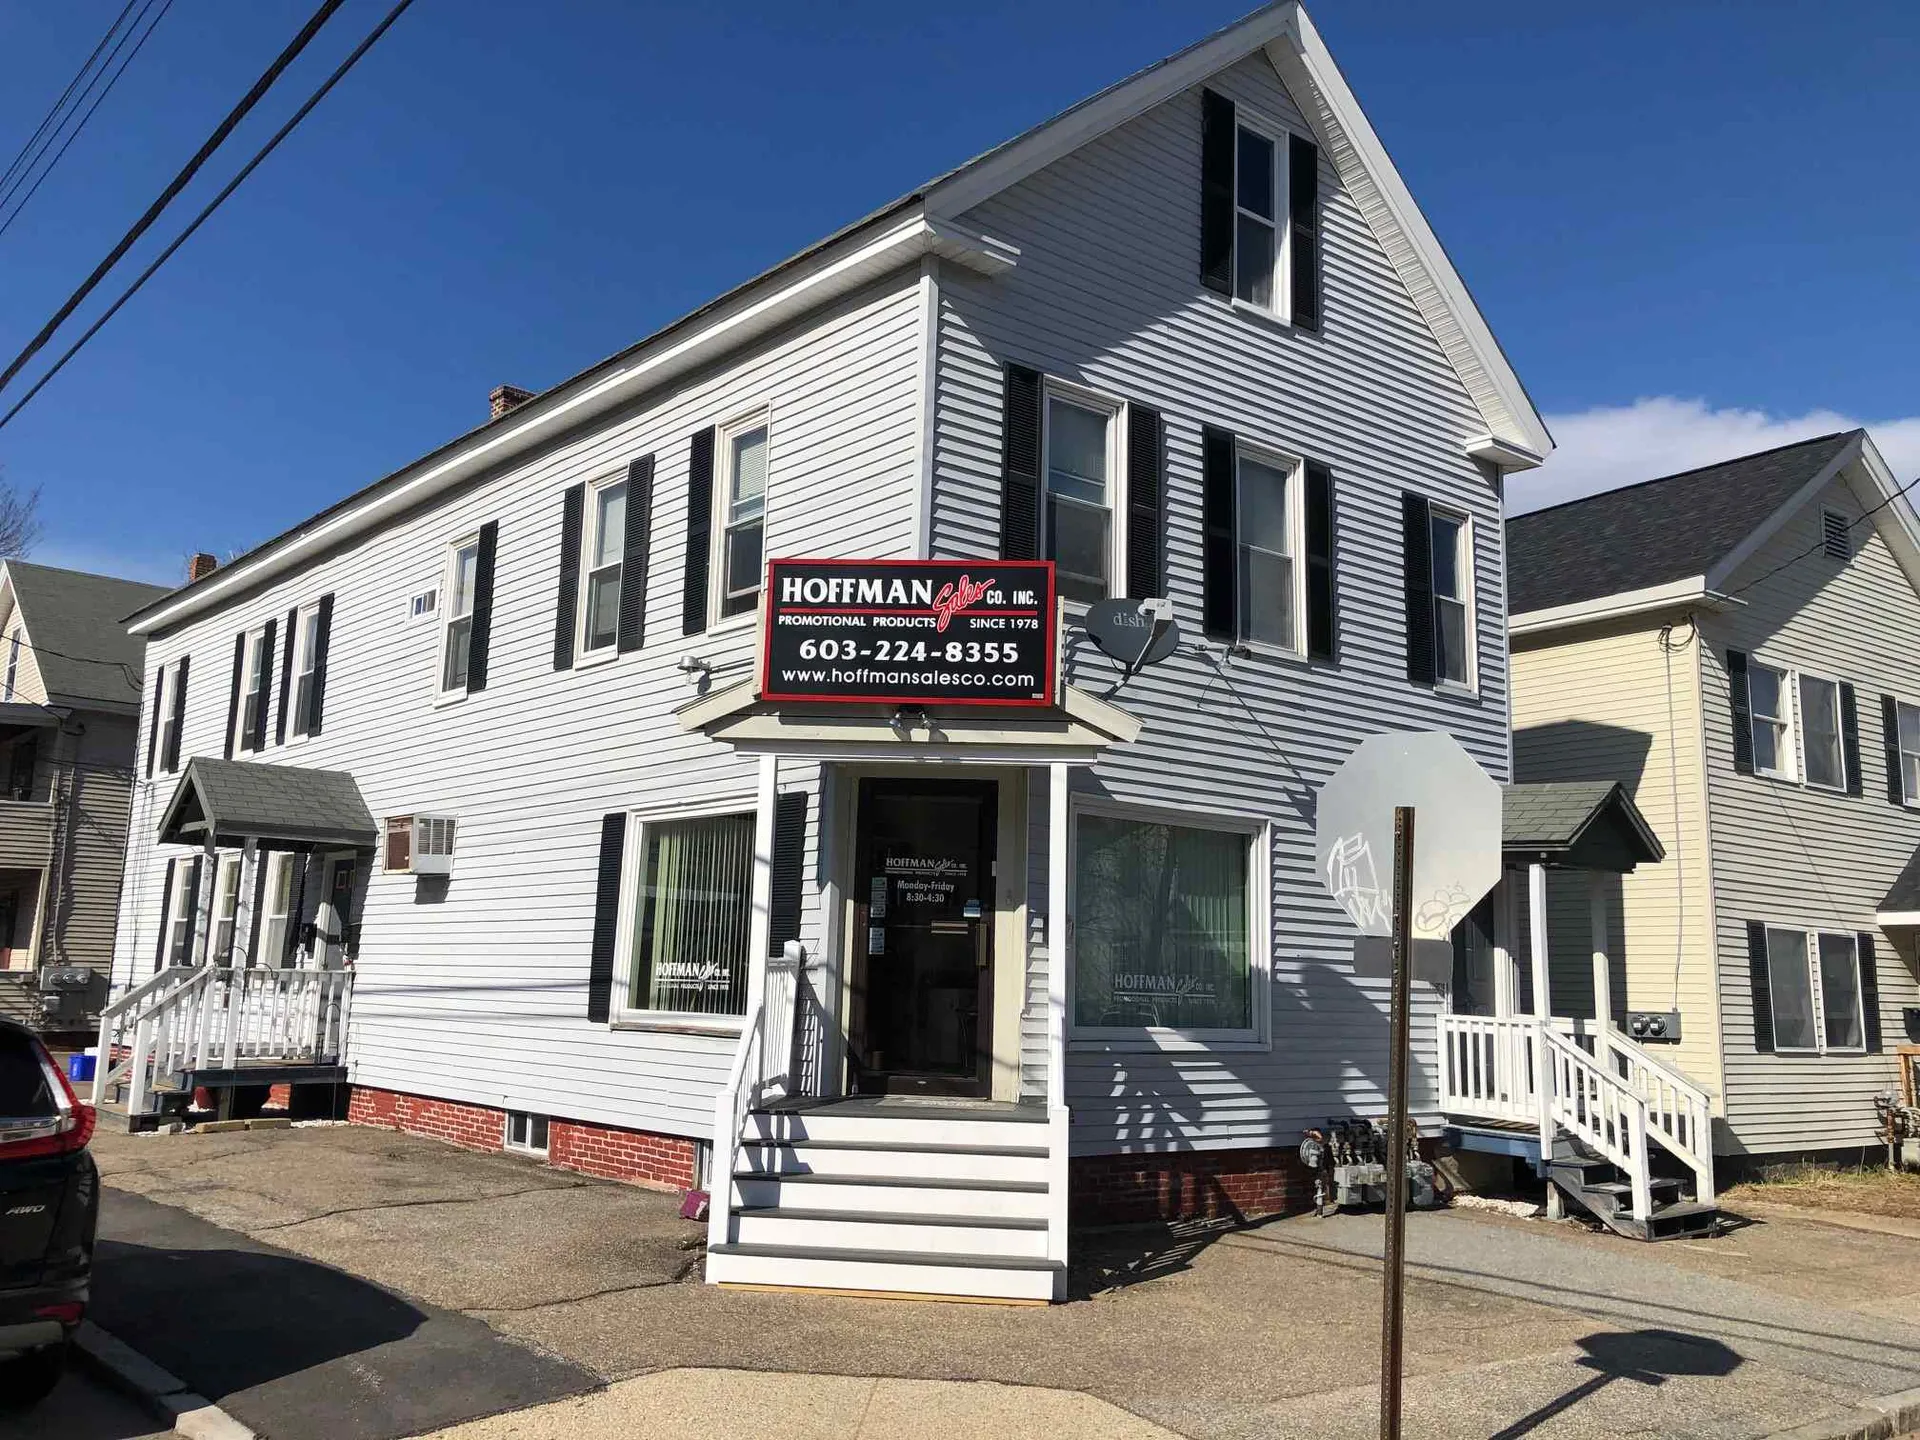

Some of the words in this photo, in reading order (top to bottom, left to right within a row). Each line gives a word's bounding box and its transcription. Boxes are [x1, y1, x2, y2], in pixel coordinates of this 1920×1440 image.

[781, 577, 932, 605] HOFFMAN
[932, 574, 996, 633] Sales
[986, 590, 1007, 605] CO.
[1013, 590, 1038, 605] INC.
[778, 615, 867, 627] PROMOTIONAL
[872, 616, 937, 628] PRODUCTS
[969, 618, 1006, 629] SINCE
[1010, 619, 1039, 629] 1978
[1113, 611, 1146, 628] dish
[799, 639, 1019, 663] 603-224-8355
[782, 668, 1035, 687] www.hoffmansalesco.com
[885, 858, 935, 868] HOFFMAN
[897, 880, 955, 892] Monday-Friday
[906, 892, 945, 903] 8:30-4:30
[655, 962, 700, 977] HOFFMAN
[1114, 973, 1176, 990] HOFFMAN
[5, 1204, 46, 1216] AWD
